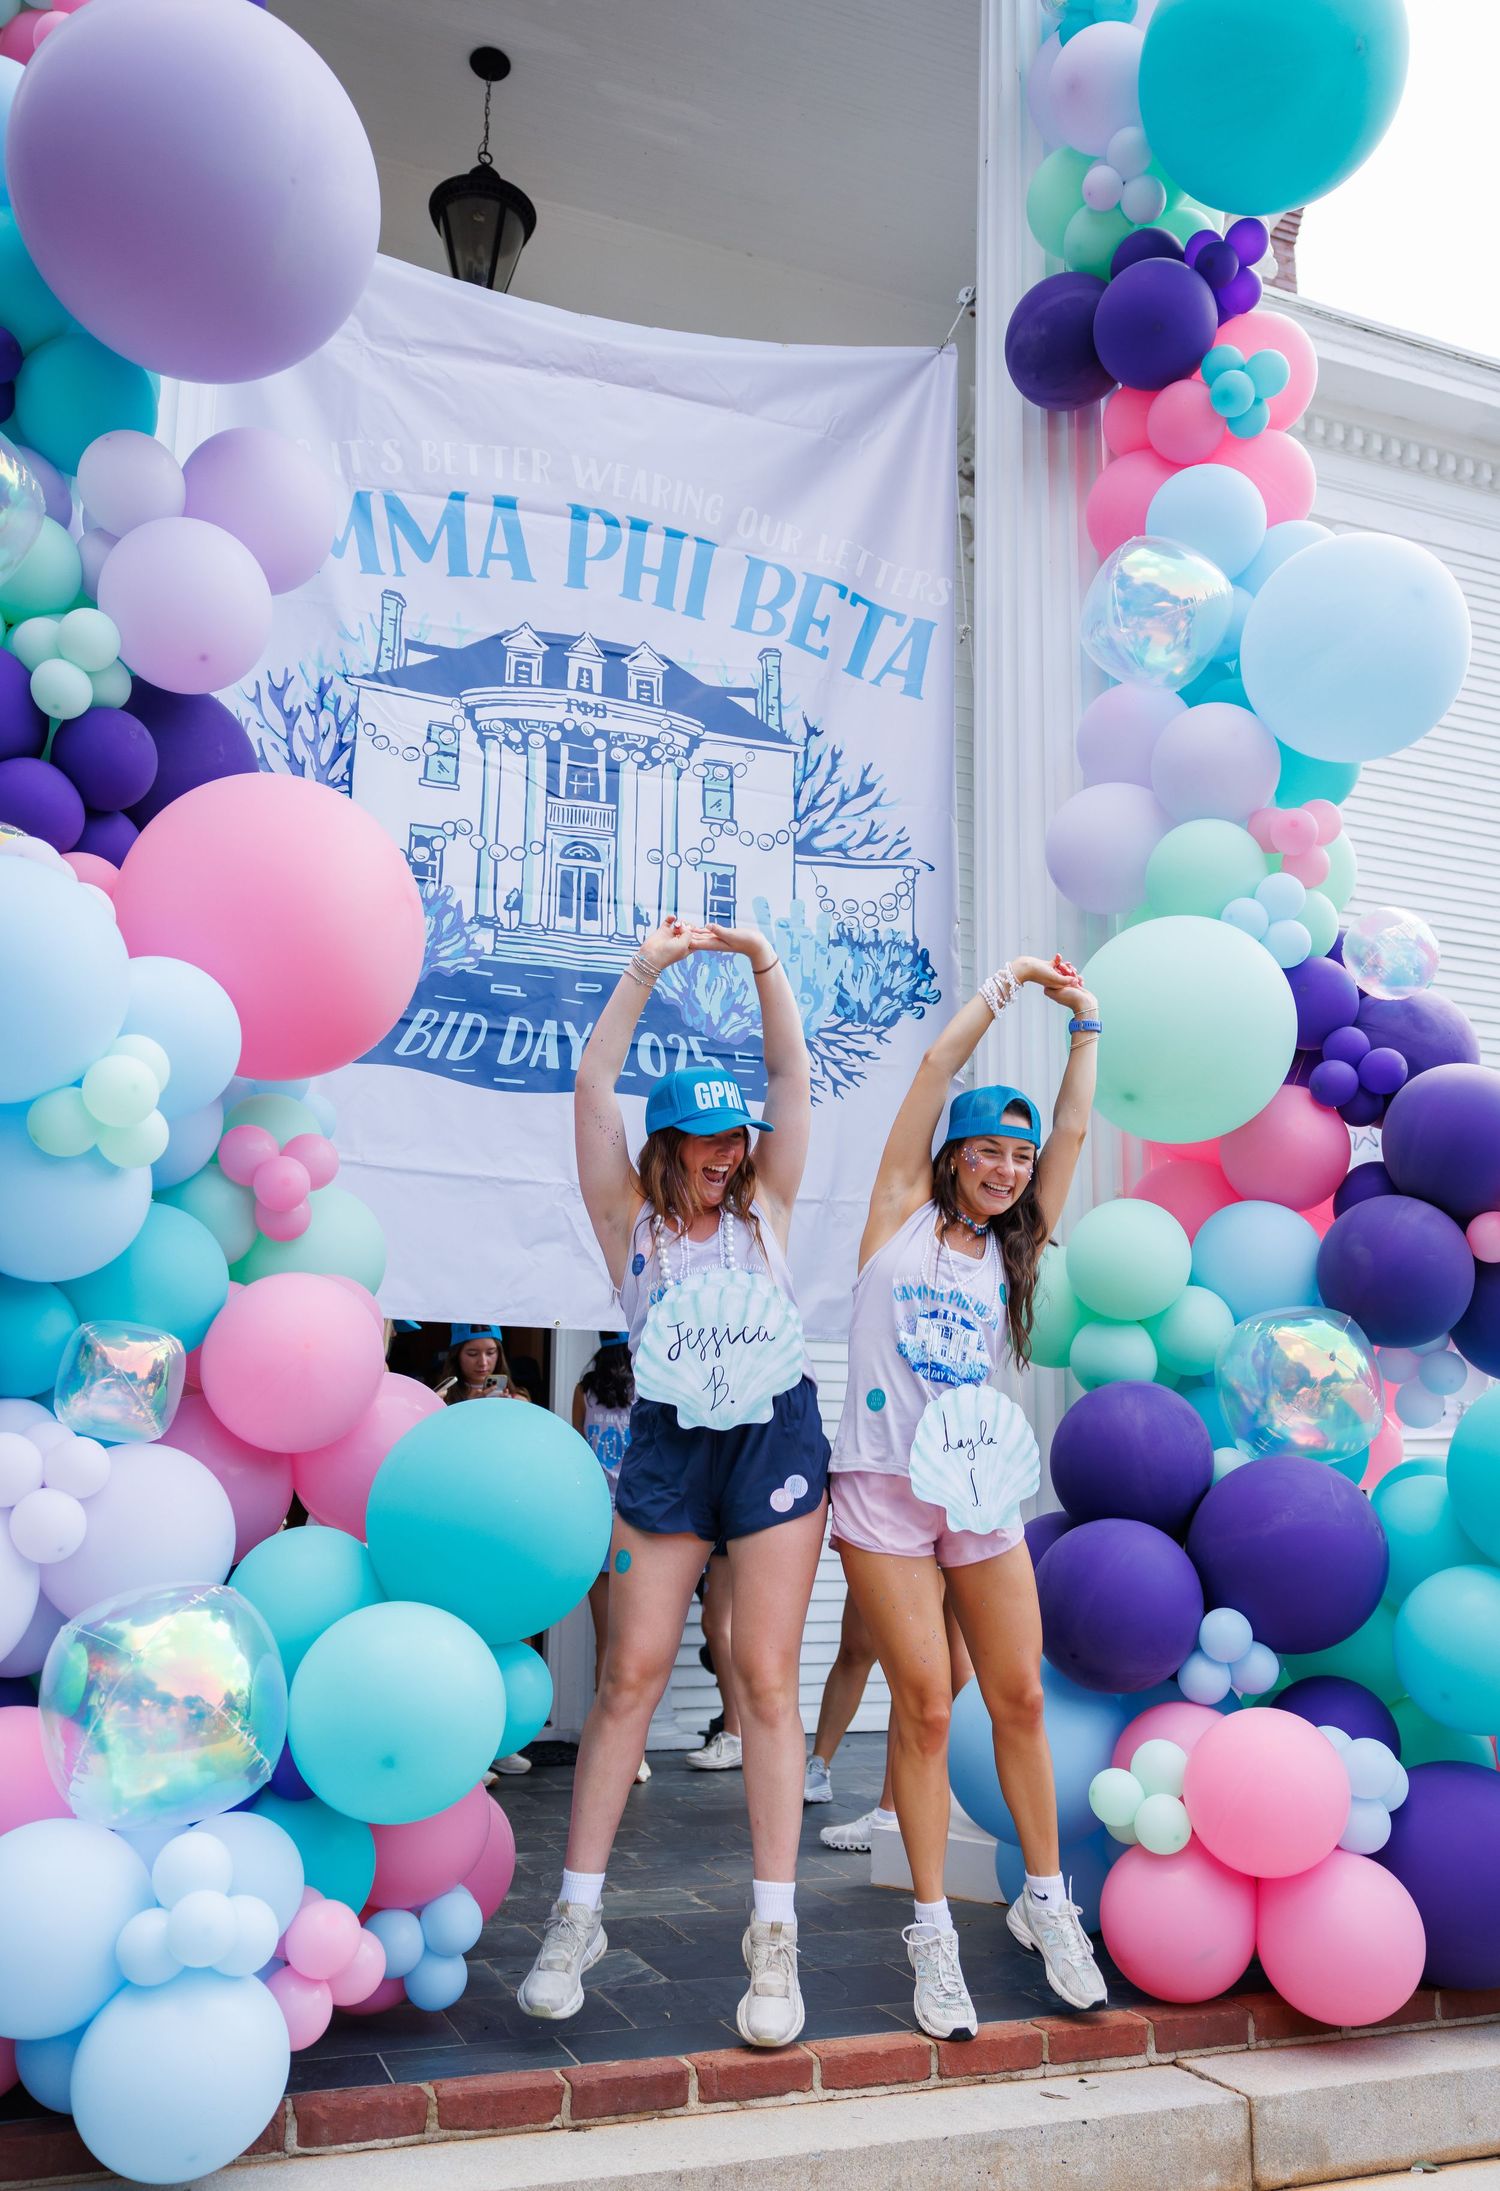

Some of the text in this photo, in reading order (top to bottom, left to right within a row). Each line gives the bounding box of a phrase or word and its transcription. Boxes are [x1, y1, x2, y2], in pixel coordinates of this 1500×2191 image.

[330, 437, 953, 607] IT'S BETTER WEARING OUR LETTERS
[317, 488, 938, 701] MMA PHI BETA
[393, 1007, 726, 1078] BID DAY 025
[693, 1080, 744, 1110] GPHI
[892, 1283, 945, 1303] GAMMA
[666, 1320, 776, 1362] Jessica
[702, 1364, 736, 1412] B.
[930, 1370, 946, 1380] DAY
[941, 1410, 998, 1461] Layla
